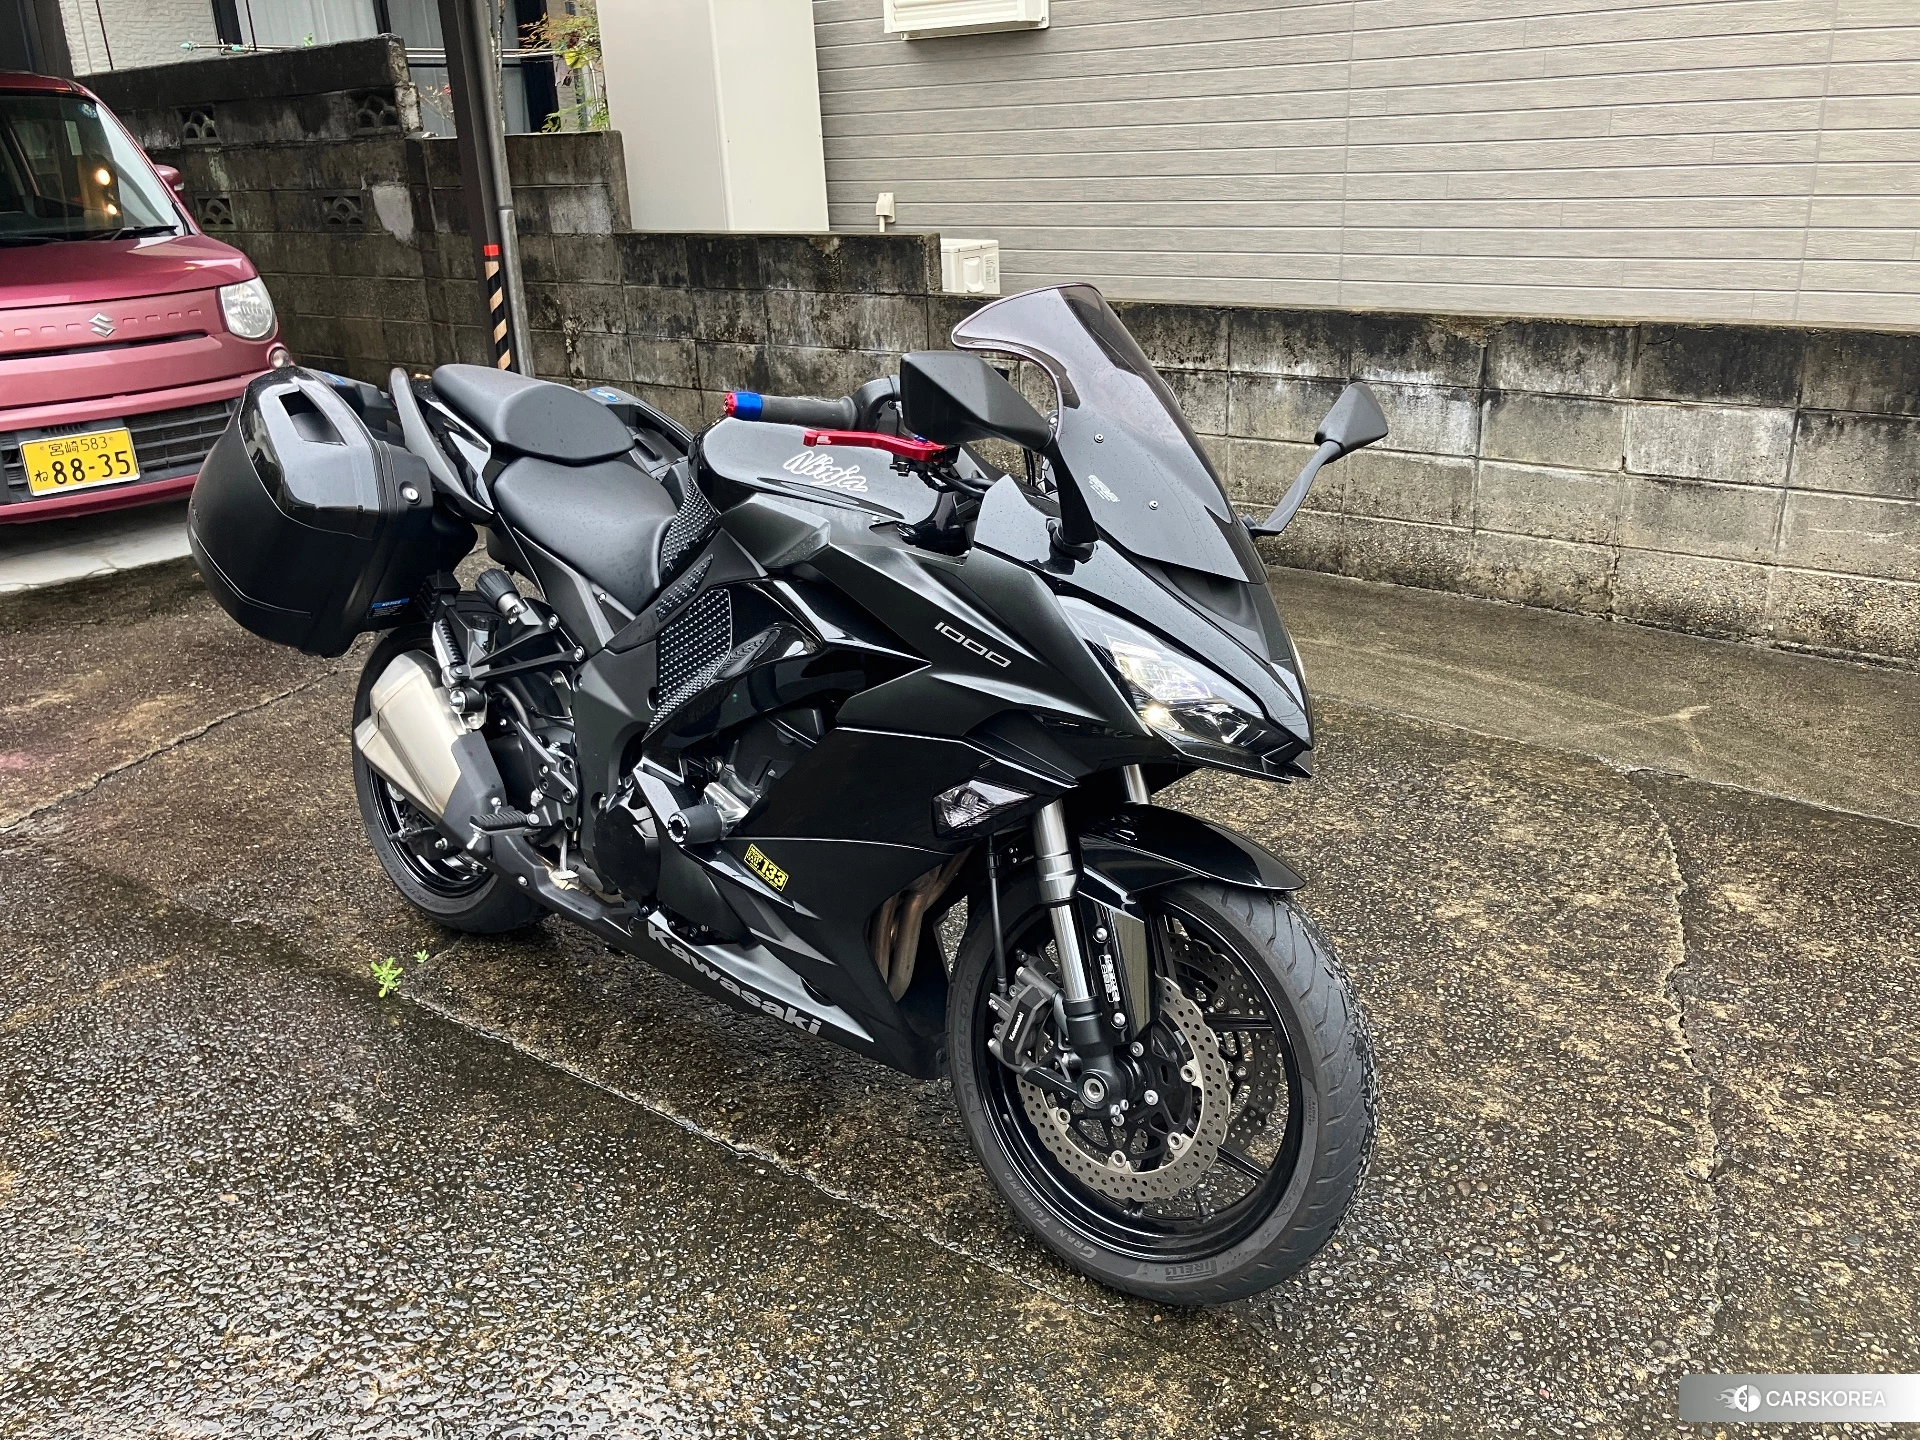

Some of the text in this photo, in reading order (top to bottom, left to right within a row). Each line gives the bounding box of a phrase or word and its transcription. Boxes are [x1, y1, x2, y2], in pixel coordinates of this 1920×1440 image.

[52, 451, 130, 484] 88-35
[783, 450, 868, 492] Ninja
[934, 621, 1012, 668] 1000
[762, 859, 787, 887] 133
[648, 921, 822, 1036] Kawasaki
[1009, 1011, 1024, 1042] Kawasaki
[1004, 1172, 1097, 1259] GRAN TURISMO
[1165, 1260, 1217, 1281] PIRELLI
